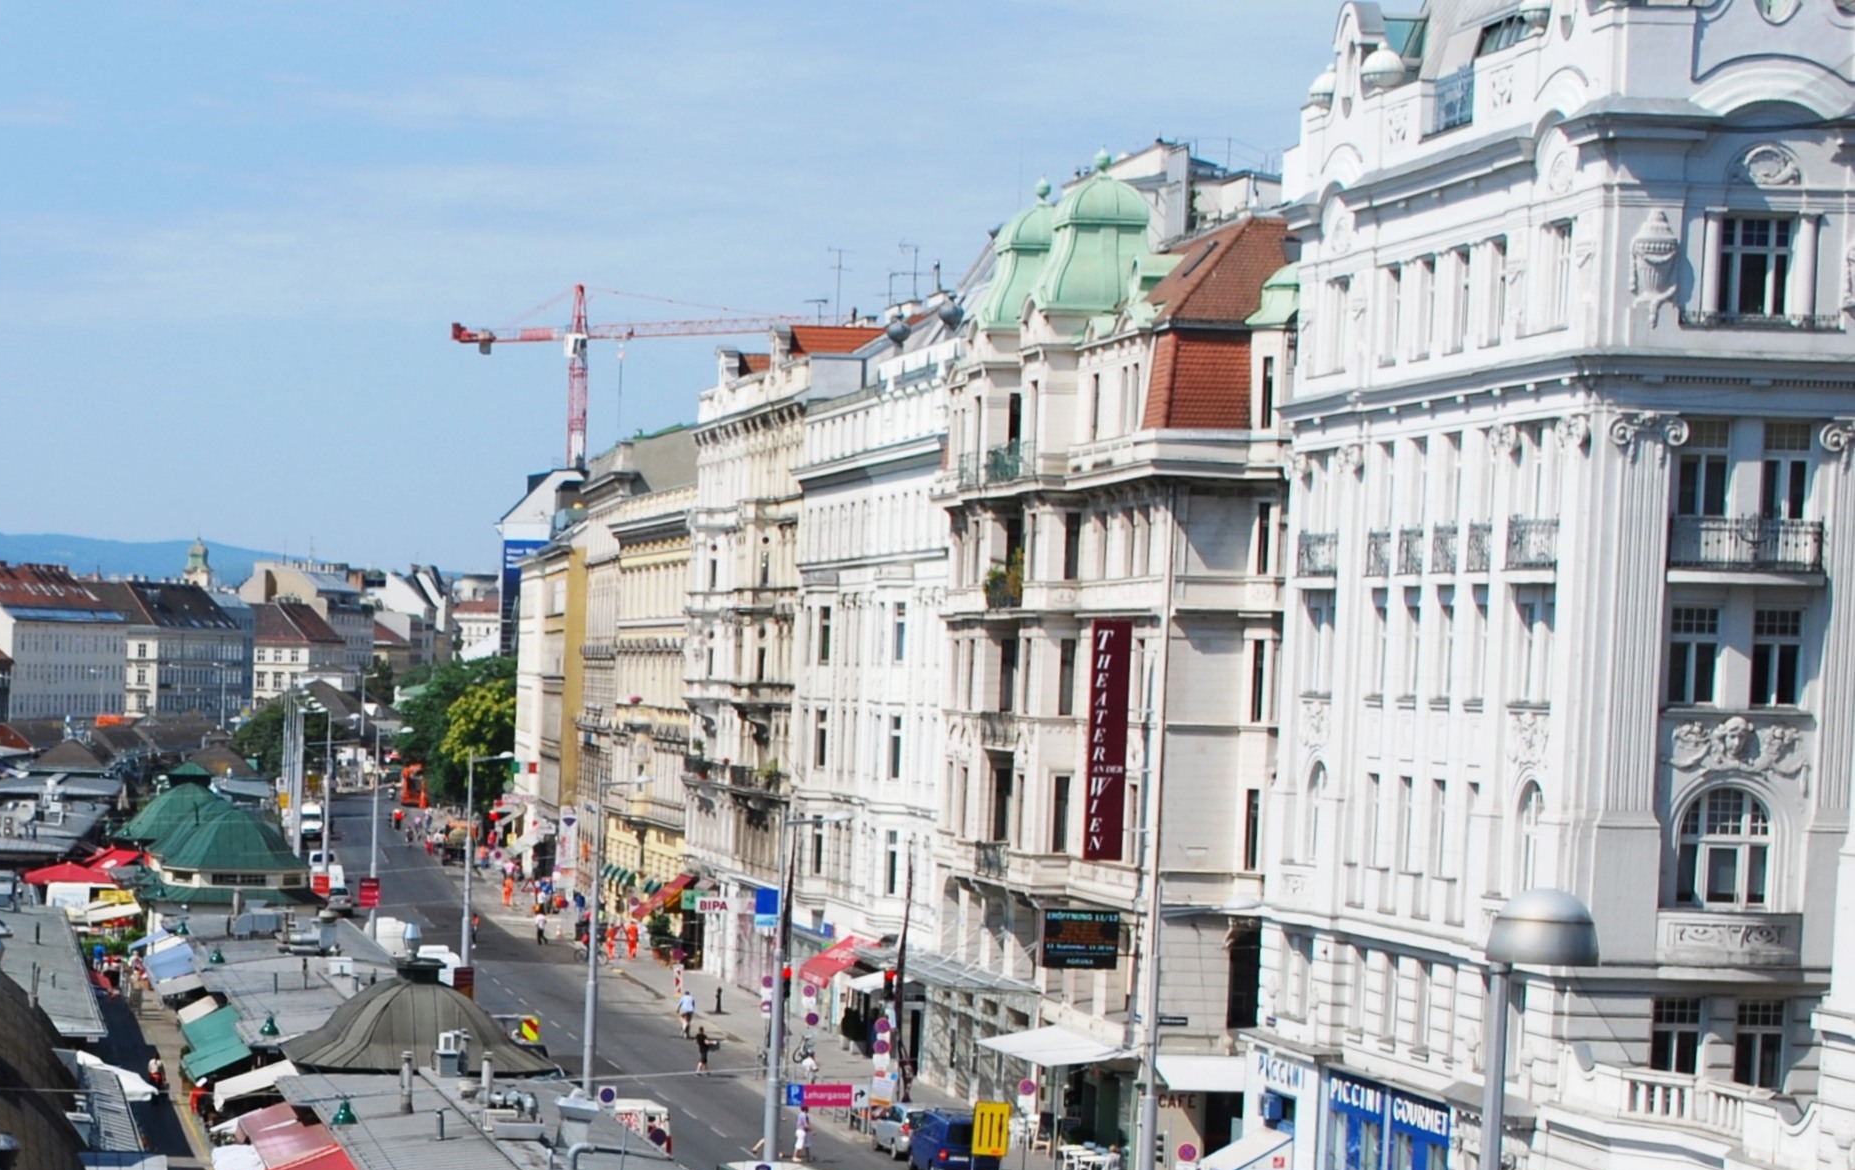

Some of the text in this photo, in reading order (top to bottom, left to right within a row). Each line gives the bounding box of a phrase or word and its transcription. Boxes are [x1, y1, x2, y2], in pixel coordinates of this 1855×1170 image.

[1092, 629, 1114, 762] THEATER
[1105, 765, 1124, 774] DER
[1088, 776, 1113, 851] WIEN
[699, 899, 728, 911] BIPA
[1258, 1054, 1306, 1090] PICCINI
[1330, 1077, 1382, 1114] PICCINI
[1393, 1097, 1449, 1136] GOURMET
